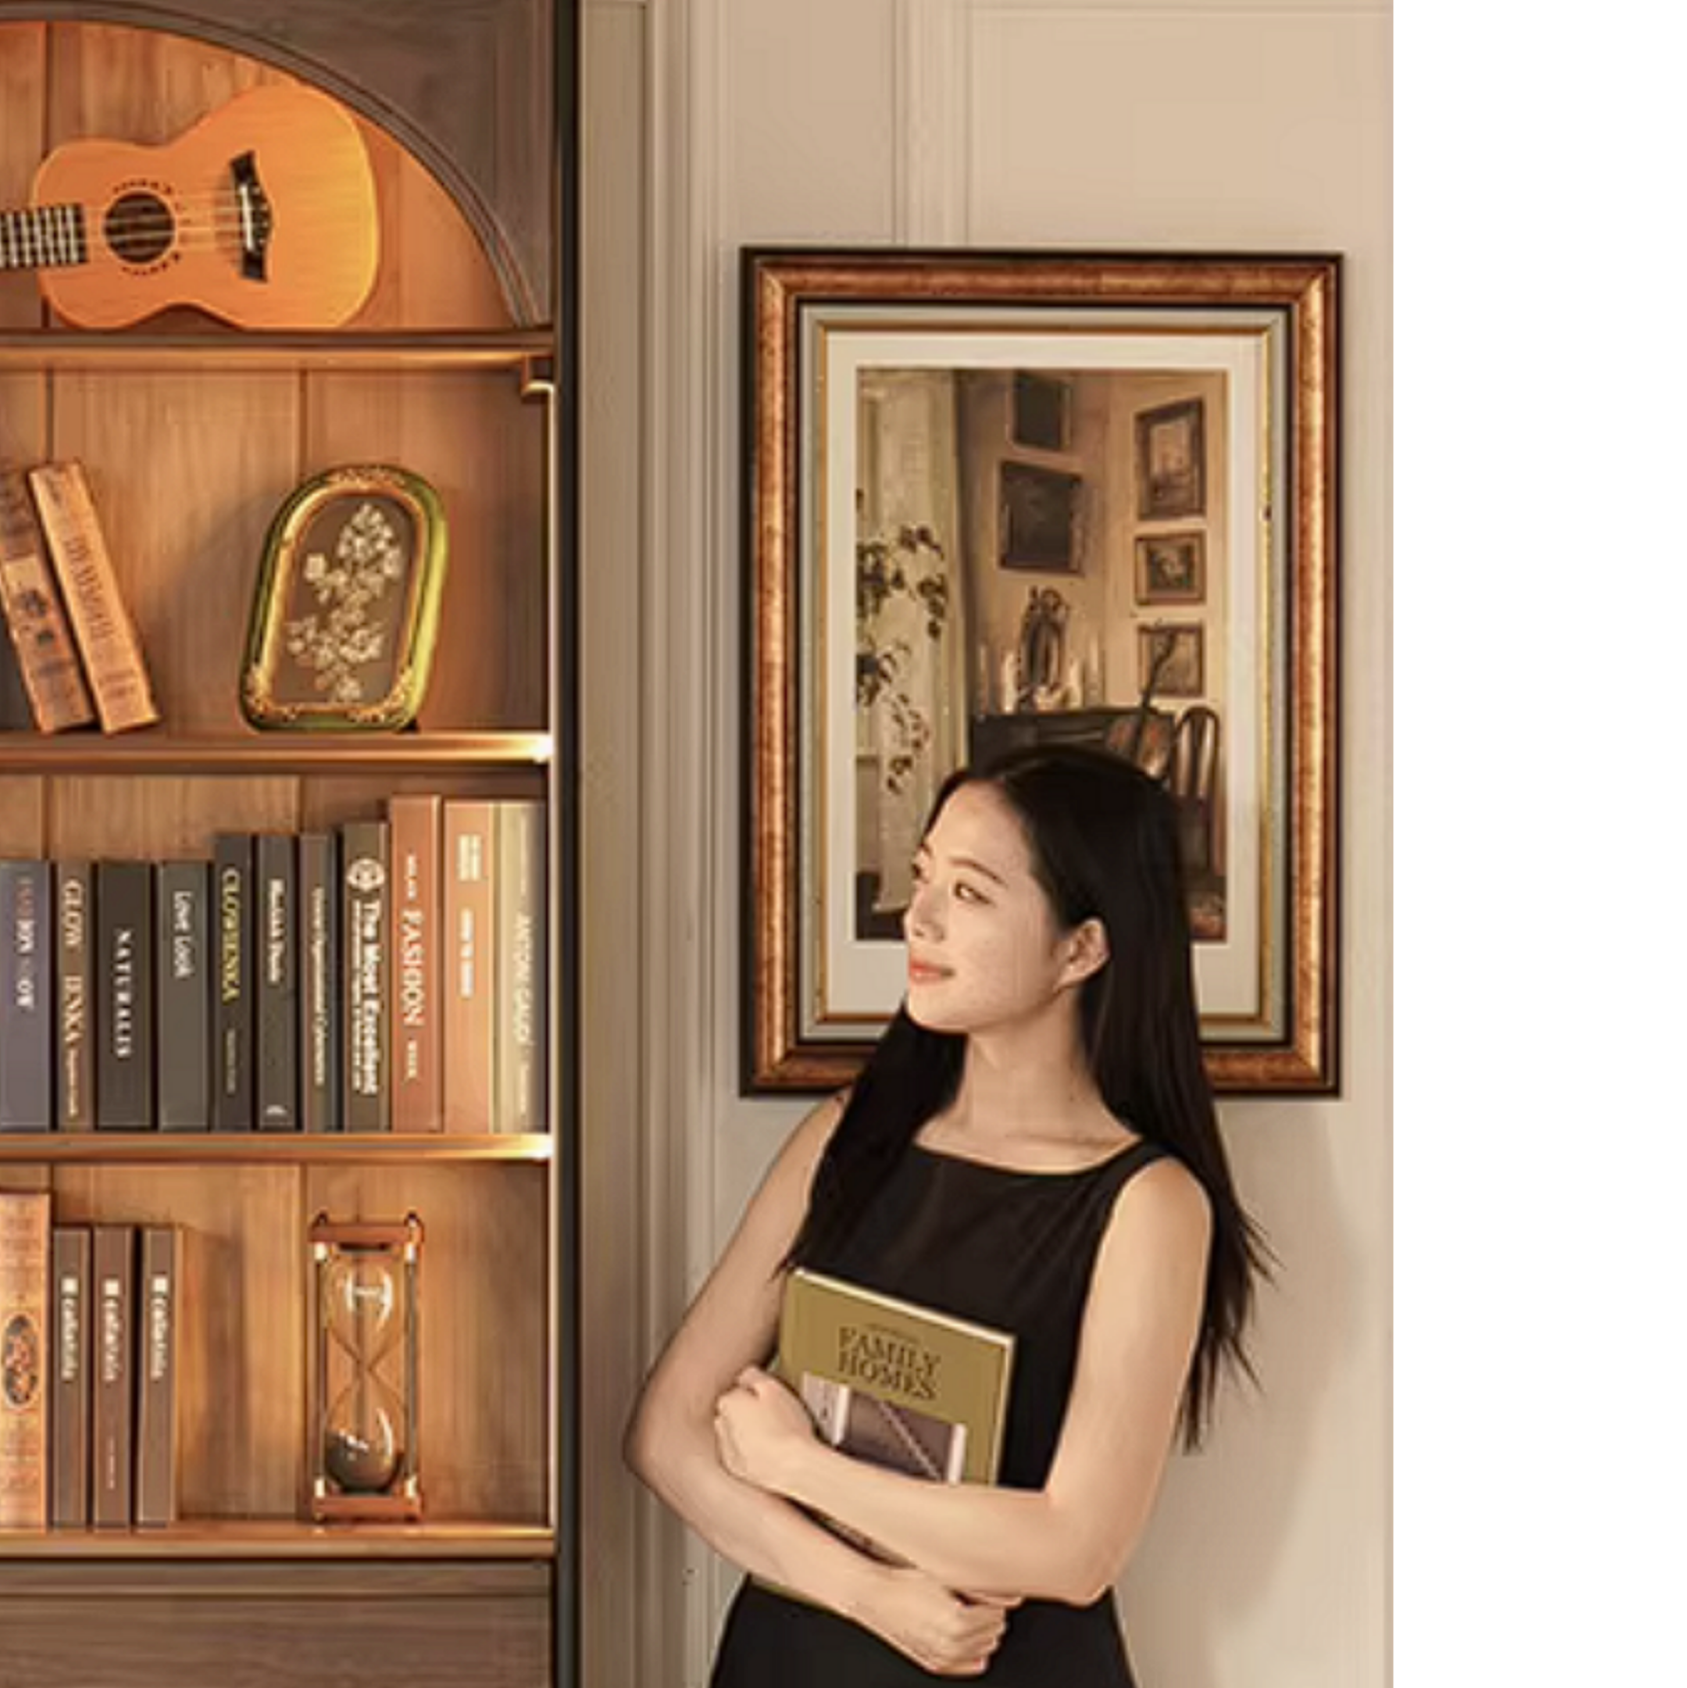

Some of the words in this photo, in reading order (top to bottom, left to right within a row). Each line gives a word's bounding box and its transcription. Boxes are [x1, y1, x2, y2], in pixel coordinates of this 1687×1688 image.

[174, 891, 193, 932] Love
[361, 900, 382, 941] The
[173, 935, 193, 978] Look
[401, 908, 424, 1027] FASHION
[113, 927, 133, 1059] NATURALIS
[838, 1326, 942, 1377] FAMILY
[838, 1350, 937, 1401] HOMES
